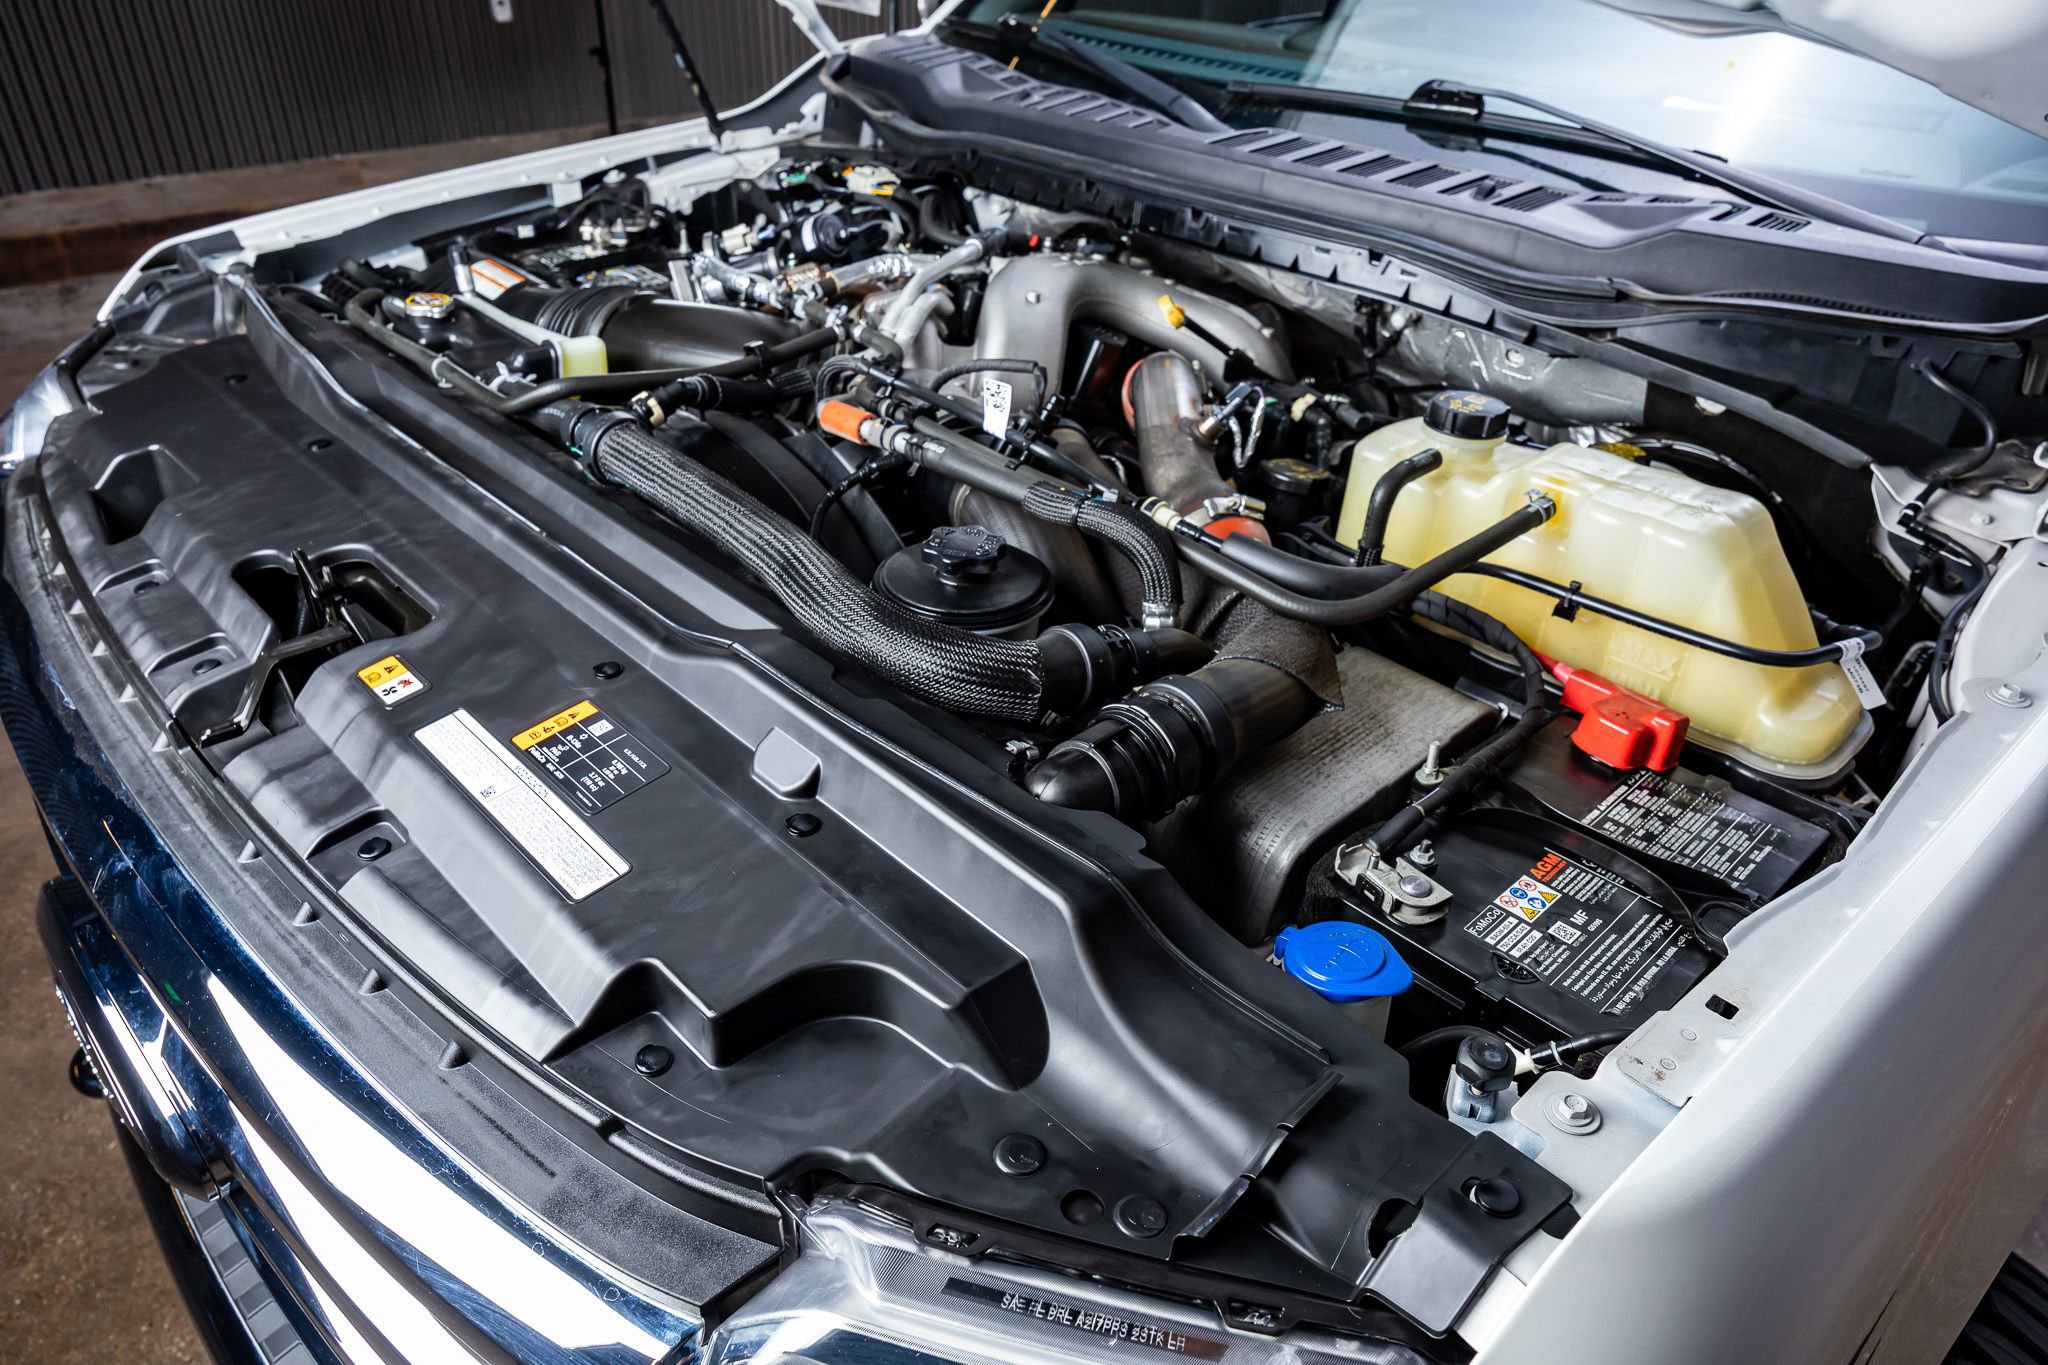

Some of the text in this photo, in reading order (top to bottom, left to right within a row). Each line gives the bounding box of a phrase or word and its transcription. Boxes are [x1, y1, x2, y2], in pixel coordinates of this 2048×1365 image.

[1530, 853, 1561, 879] AGM
[1469, 908, 1501, 935] FoMoCo
[1569, 909, 1589, 926] MF
[1001, 1294, 1026, 1313] SAE
